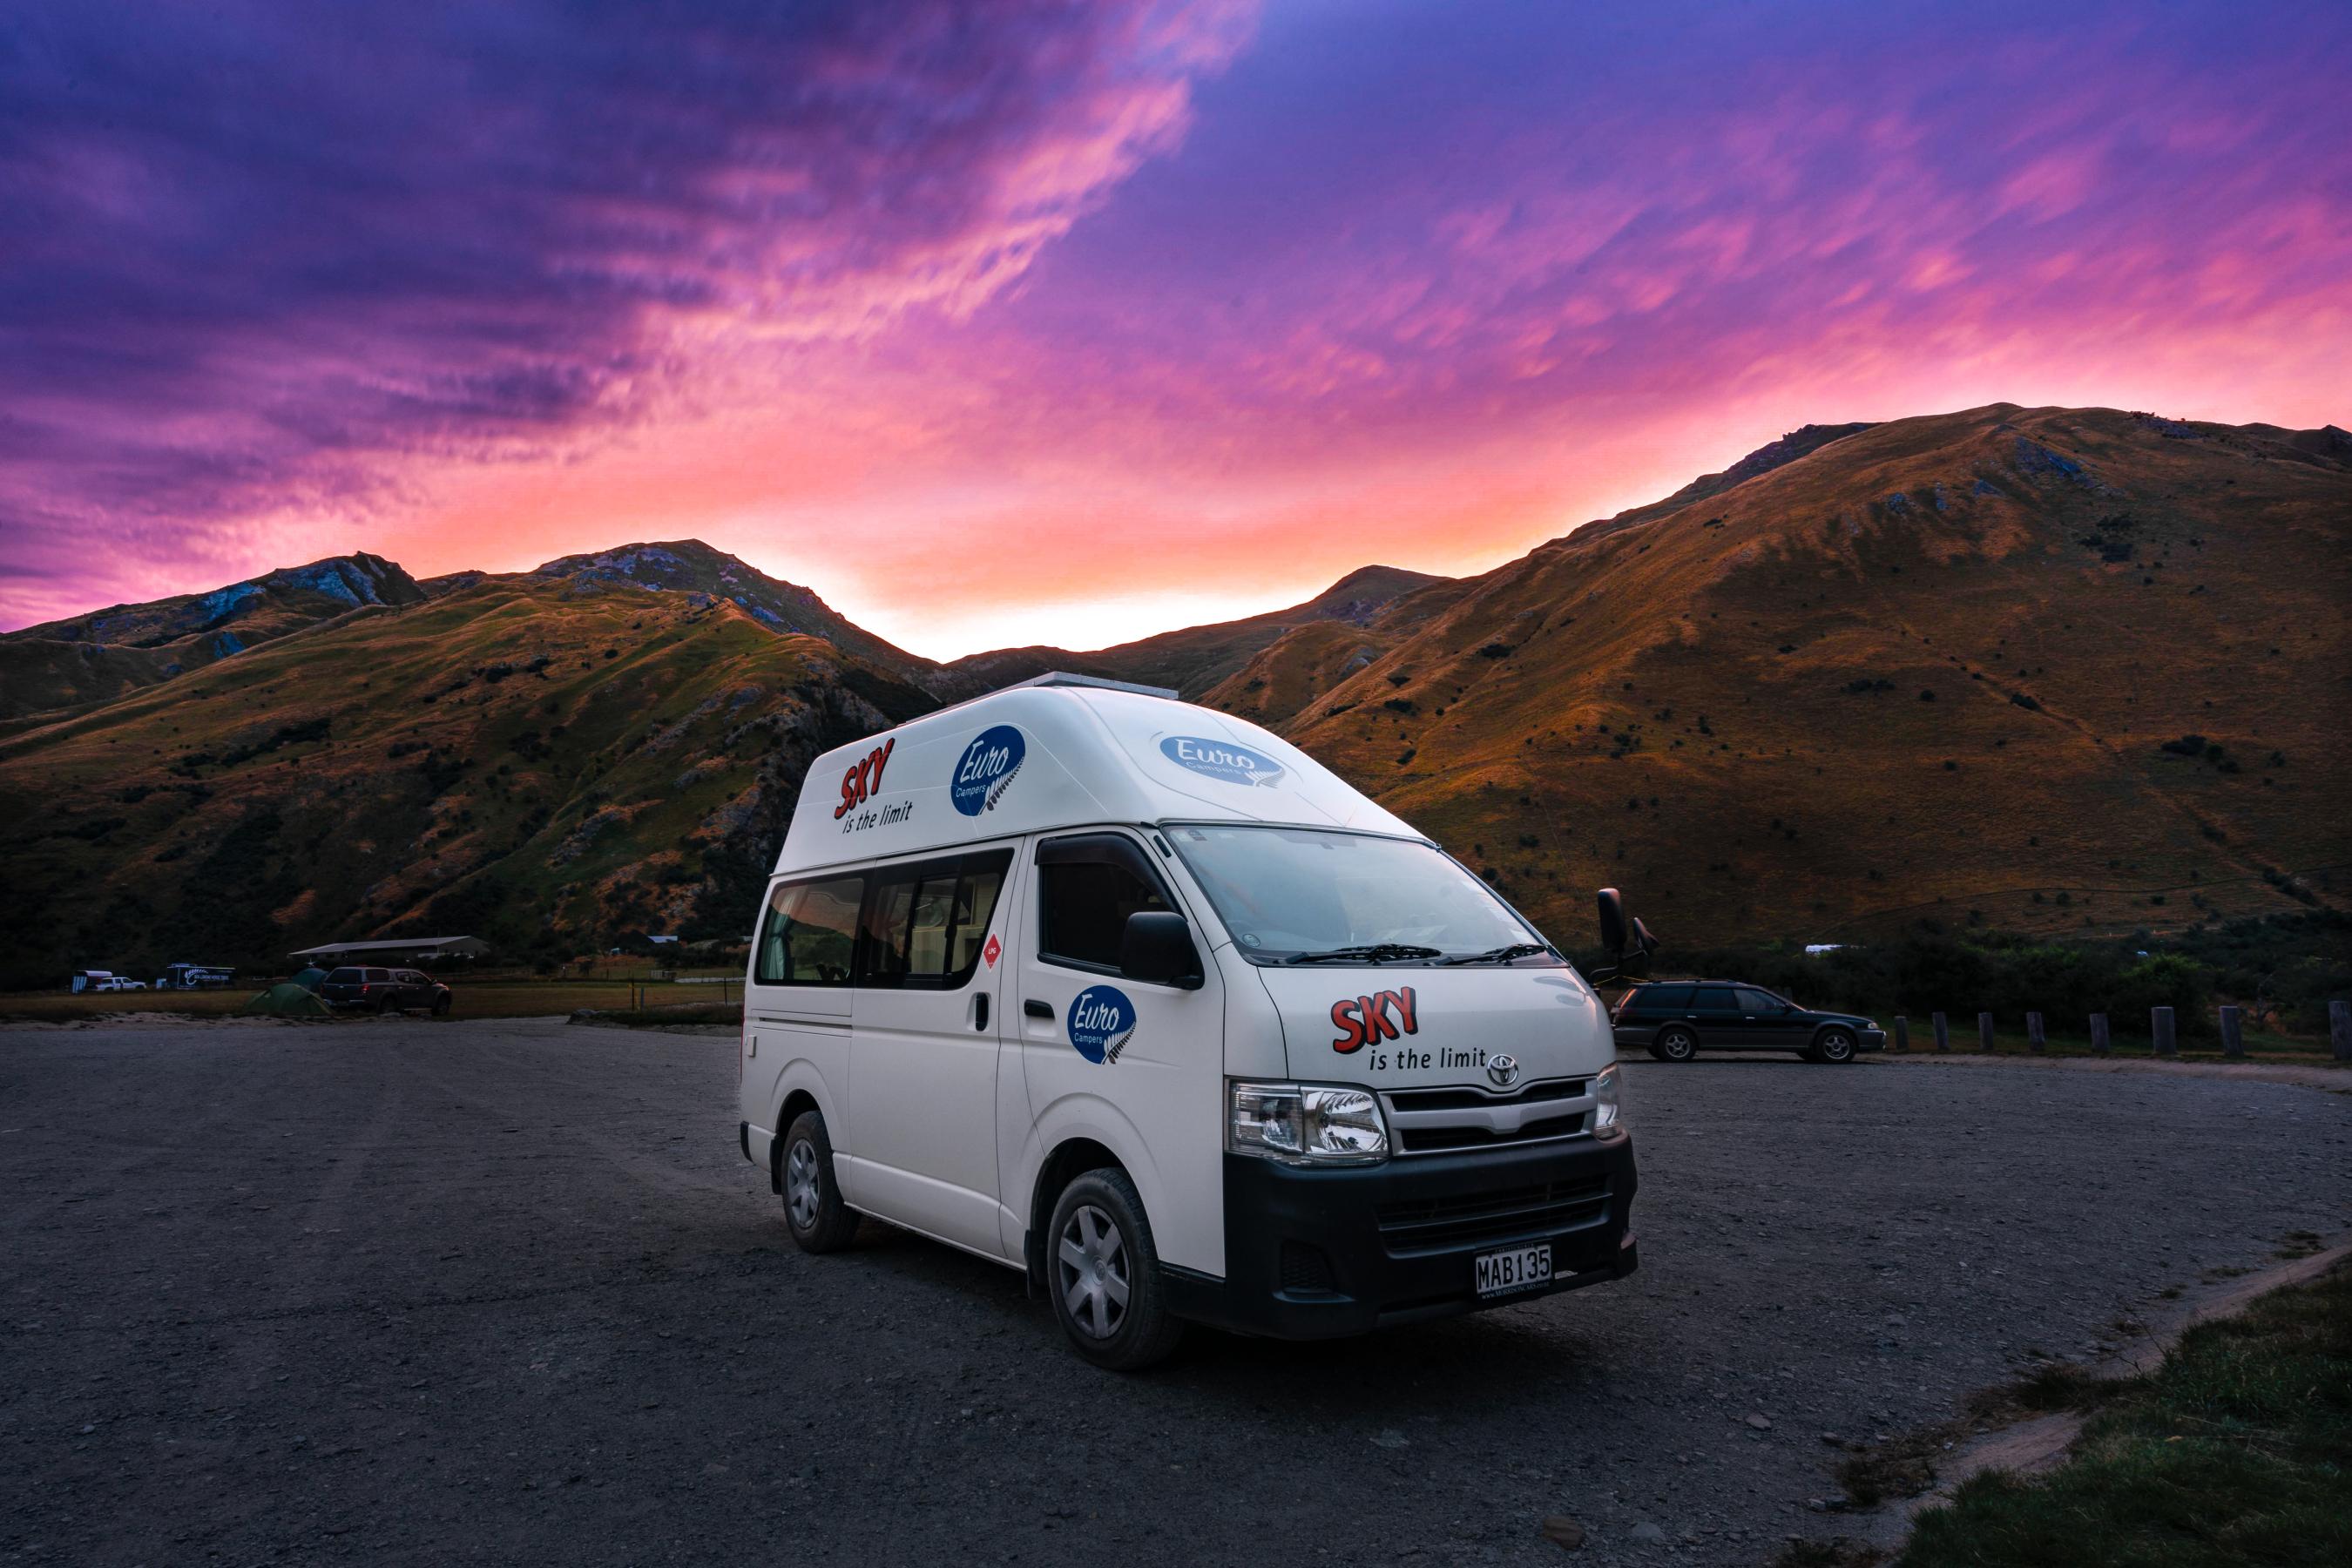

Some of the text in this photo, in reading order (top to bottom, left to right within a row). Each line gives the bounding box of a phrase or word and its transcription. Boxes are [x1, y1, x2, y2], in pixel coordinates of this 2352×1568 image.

[959, 740, 1010, 784] Euro
[1174, 738, 1255, 770] Euro
[1186, 761, 1243, 775] Campers
[834, 737, 896, 820] SKY
[956, 784, 987, 798] Campers
[842, 801, 913, 835] is the limit
[1074, 993, 1120, 1031] Euro
[1330, 986, 1419, 1055] SKY
[1074, 1032, 1103, 1044] Campers
[1369, 1047, 1486, 1071] is the limit
[1477, 1248, 1551, 1290] MAB135
